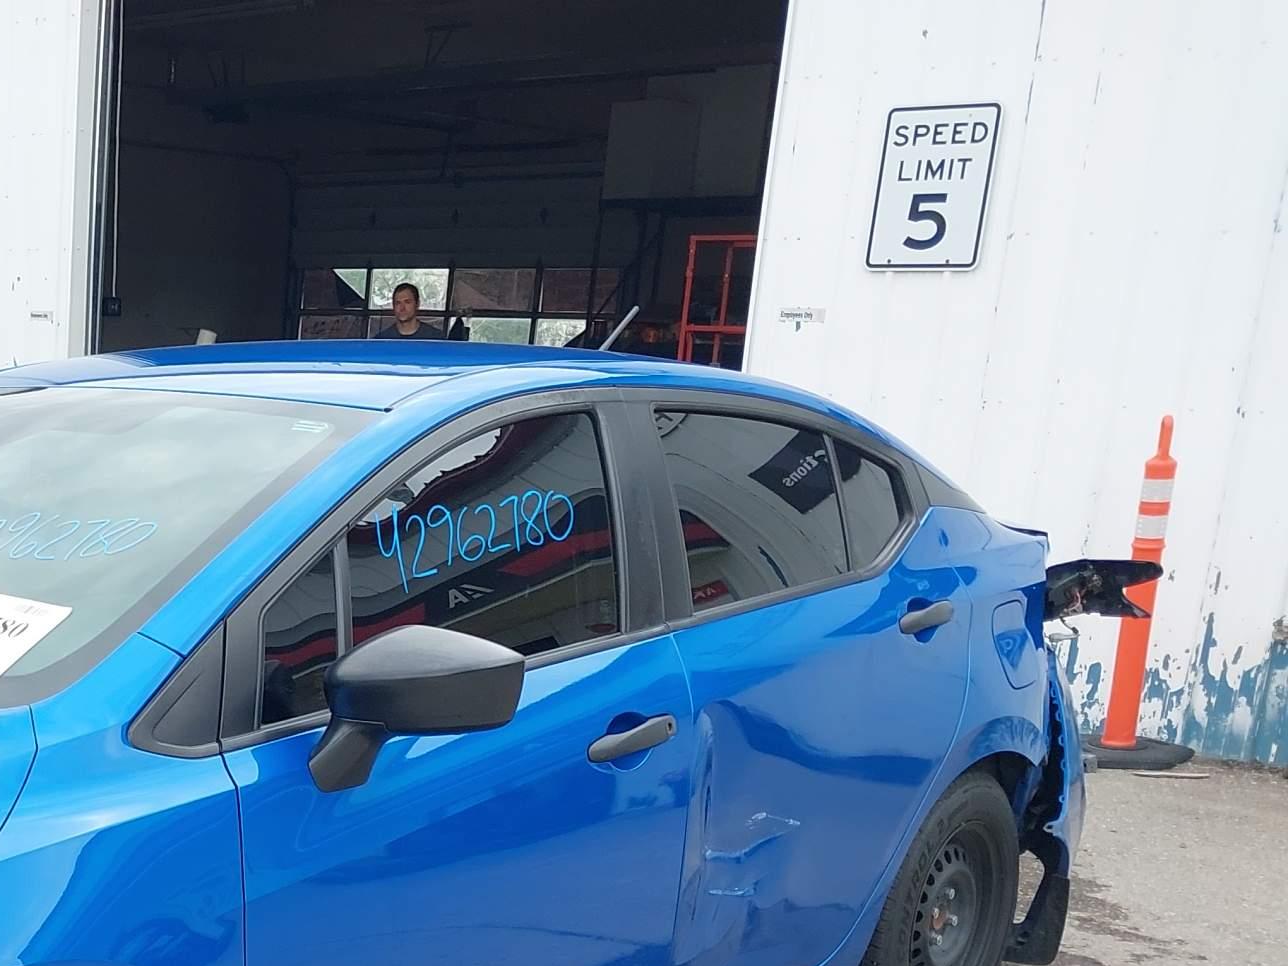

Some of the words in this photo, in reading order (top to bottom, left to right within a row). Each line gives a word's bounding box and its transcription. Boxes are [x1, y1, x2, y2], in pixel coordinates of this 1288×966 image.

[893, 121, 989, 147] SPEED
[897, 158, 973, 181] LIMIT
[902, 192, 949, 251] 5
[374, 489, 575, 595] 42962780
